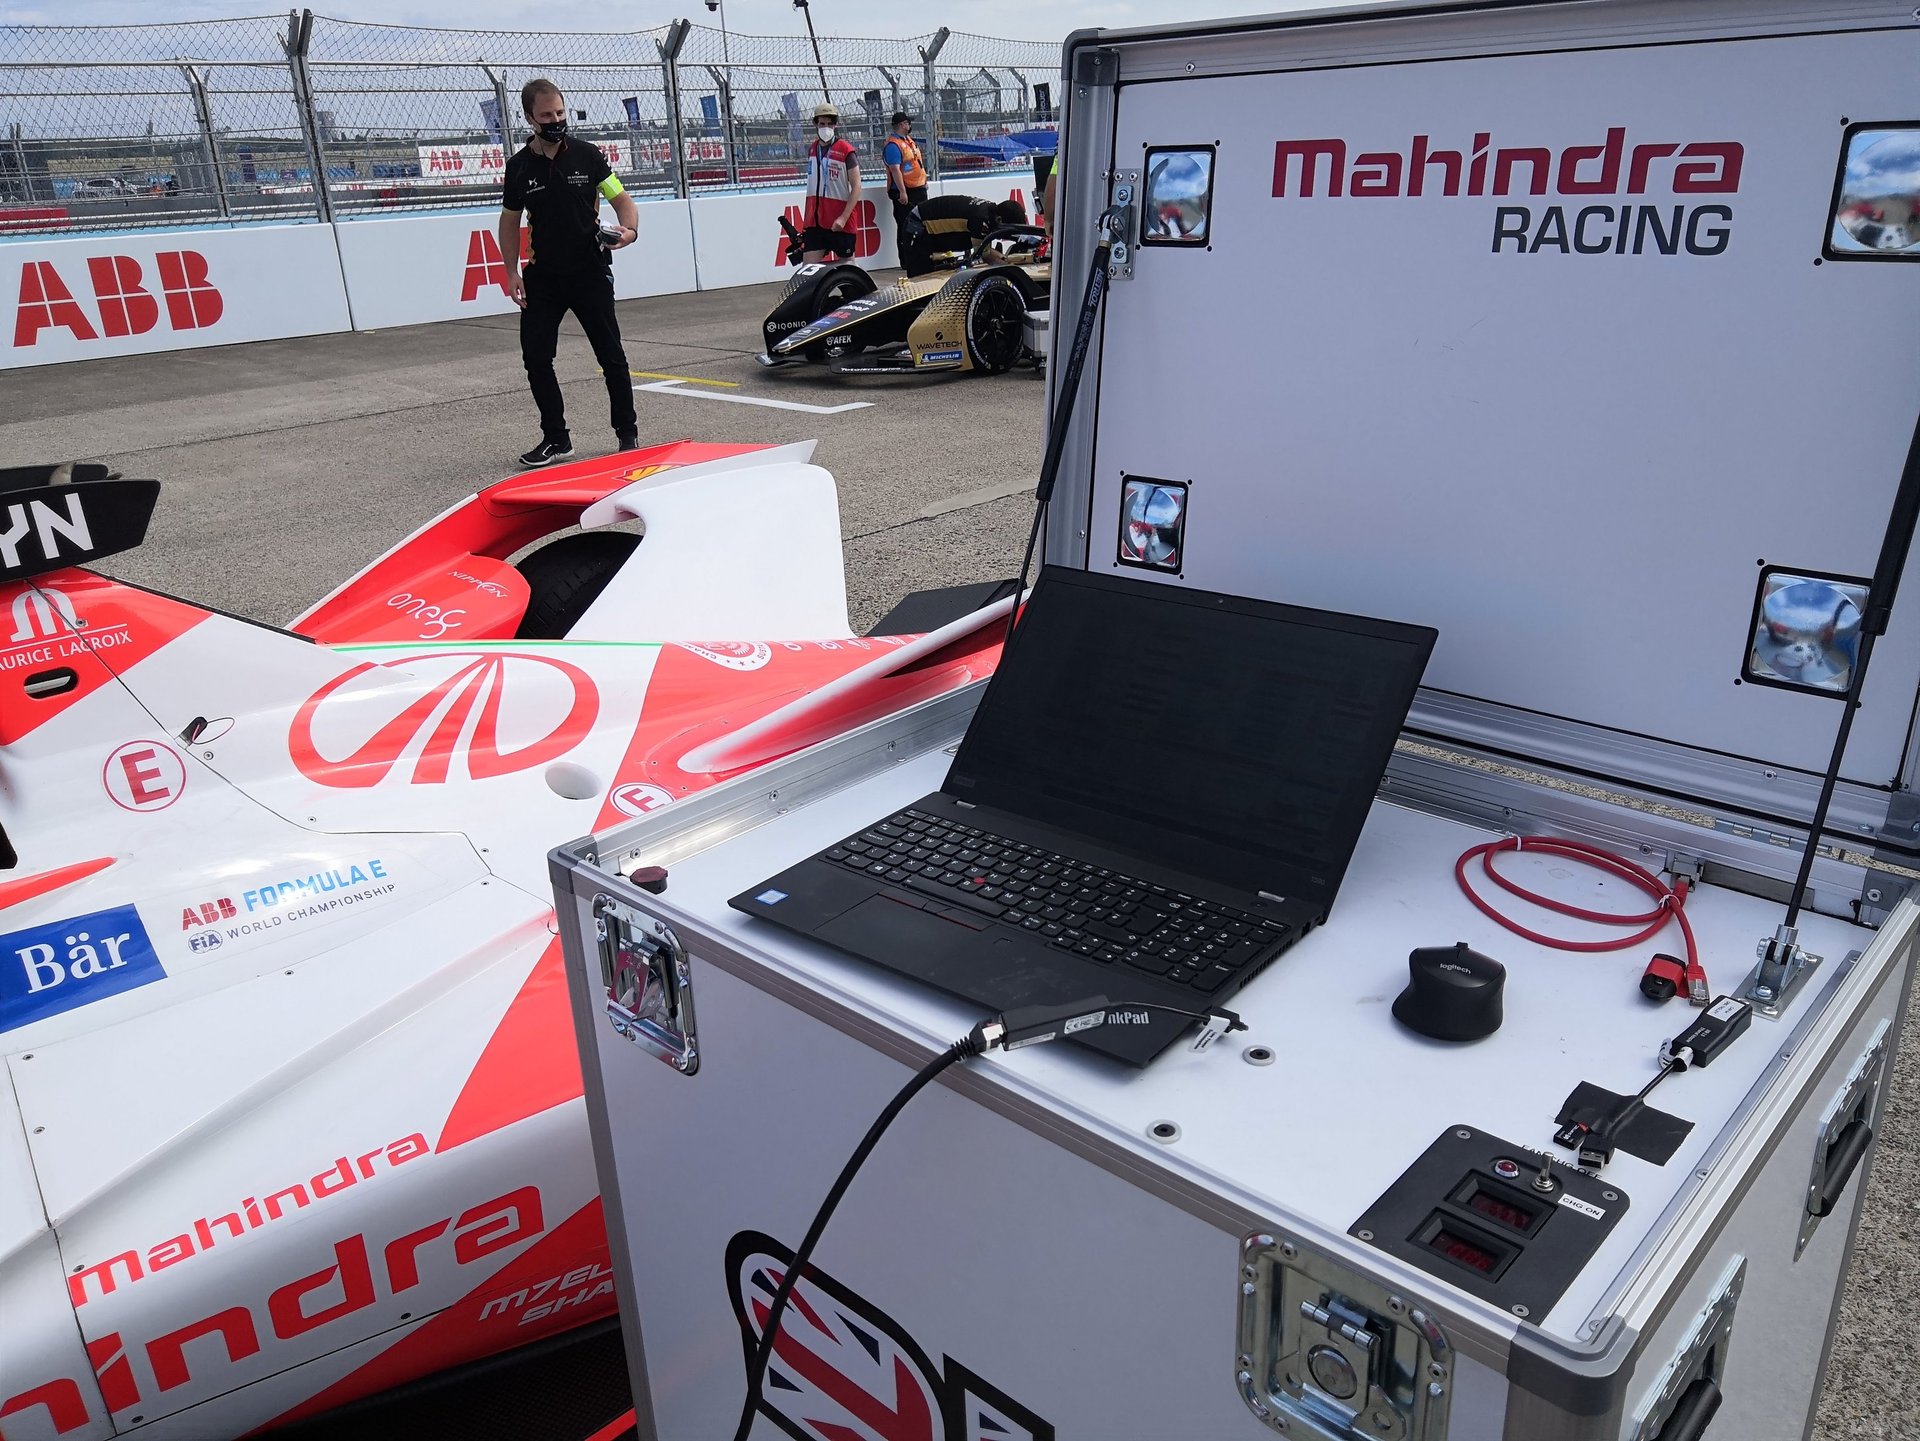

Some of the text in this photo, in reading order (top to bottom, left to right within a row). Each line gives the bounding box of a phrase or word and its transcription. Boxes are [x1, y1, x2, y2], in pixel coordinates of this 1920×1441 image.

[1491, 205, 1733, 256] RACING
[14, 250, 223, 347] ABB
[916, 340, 963, 350] WAVETECH
[930, 352, 960, 361] MICHELIN
[61, 631, 132, 657] LACROIX
[120, 748, 171, 805] E
[182, 859, 387, 930] ABB FORMULA E
[226, 916, 282, 940] WORLD
[287, 883, 396, 923] CHAMPIONSHIP
[15, 930, 130, 994] Bär
[1440, 961, 1472, 976] logitech
[1108, 1011, 1150, 1025] nkPad
[68, 1132, 430, 1309] mahindra
[1562, 1197, 1601, 1217] CHG ON
